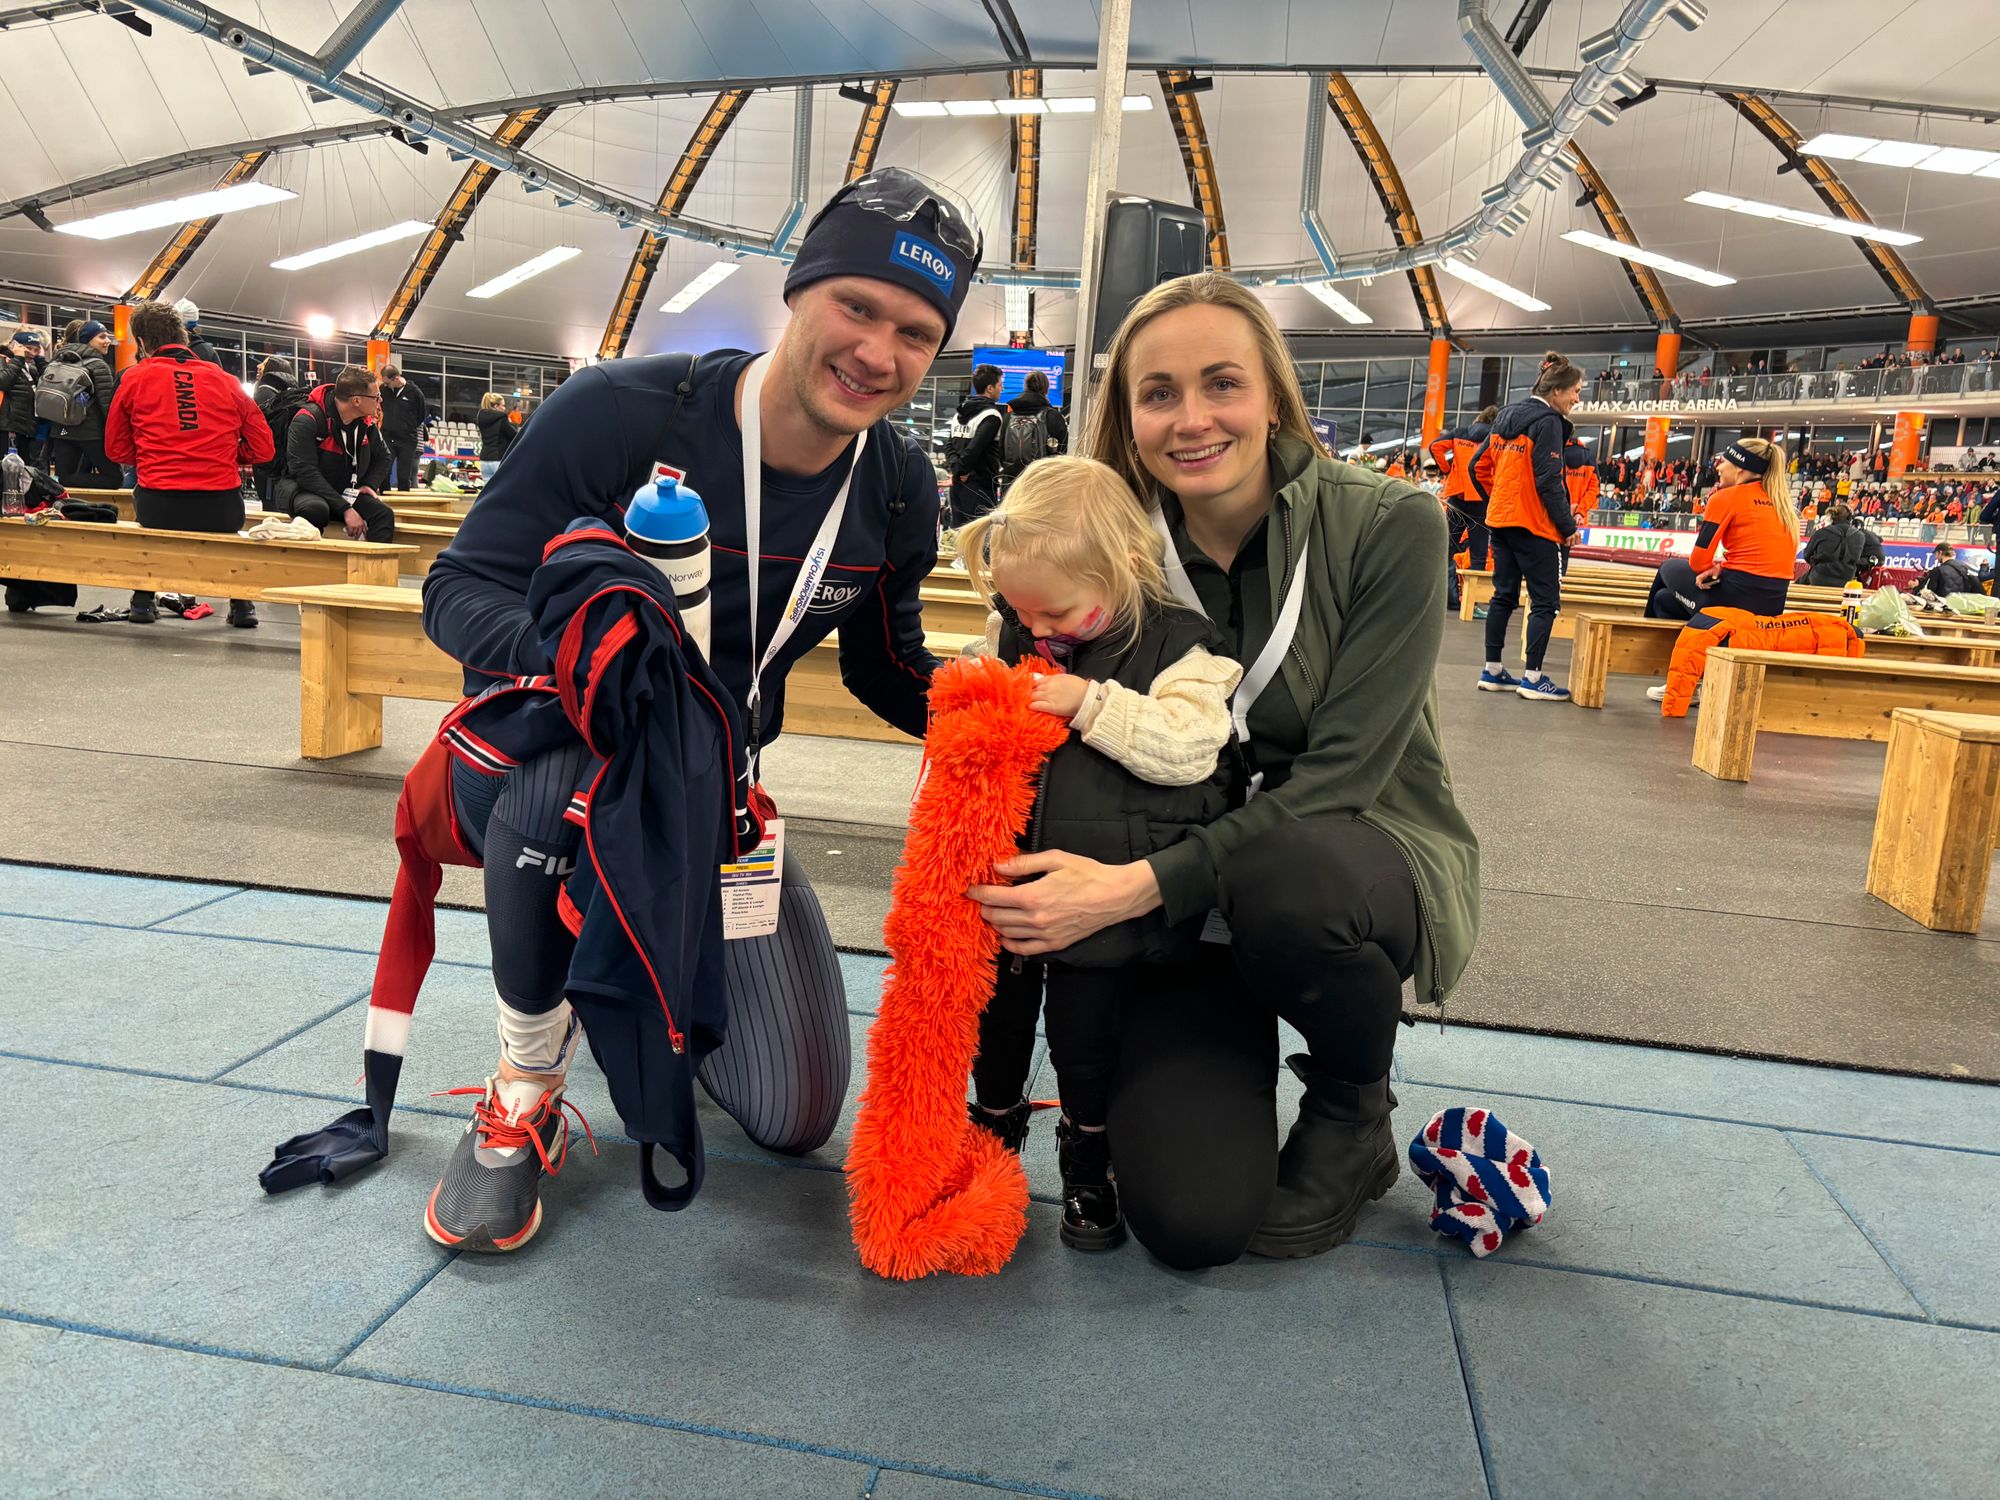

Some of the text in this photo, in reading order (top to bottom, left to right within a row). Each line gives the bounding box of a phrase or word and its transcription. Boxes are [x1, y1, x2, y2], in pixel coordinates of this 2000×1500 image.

[899, 241, 952, 280] LERØY
[174, 371, 199, 431] CANADA
[1587, 399, 1738, 412] MAX AICHER ARENA
[1605, 532, 1675, 554] univé
[1883, 552, 1922, 569] merica
[669, 568, 704, 582] Norway
[789, 564, 819, 621] CHAMPIONSHIPS
[813, 583, 857, 601] ERØY
[1675, 591, 1696, 610] JUMBO
[516, 846, 577, 876] FIL
